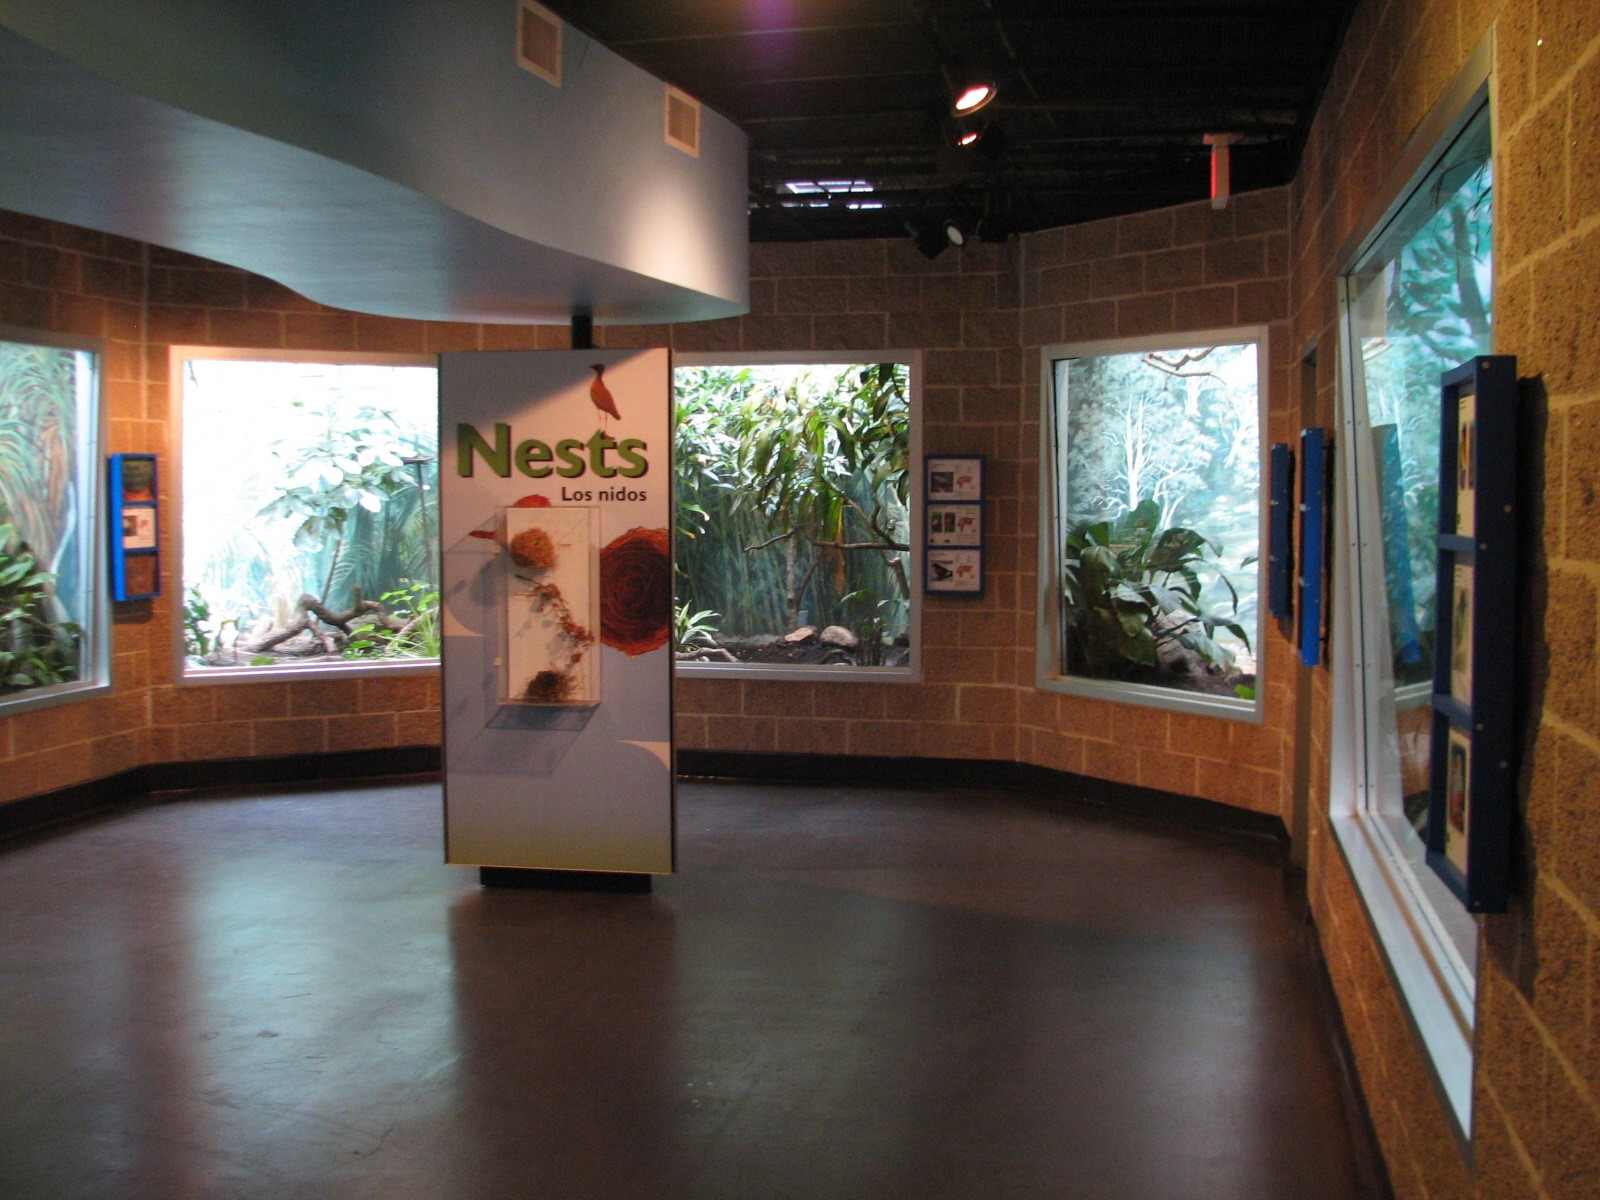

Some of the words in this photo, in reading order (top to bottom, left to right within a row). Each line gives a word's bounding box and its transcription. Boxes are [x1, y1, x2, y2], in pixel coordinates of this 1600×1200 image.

[457, 423, 648, 478] Nests
[562, 486, 592, 502] Los
[598, 486, 647, 502] nidos
